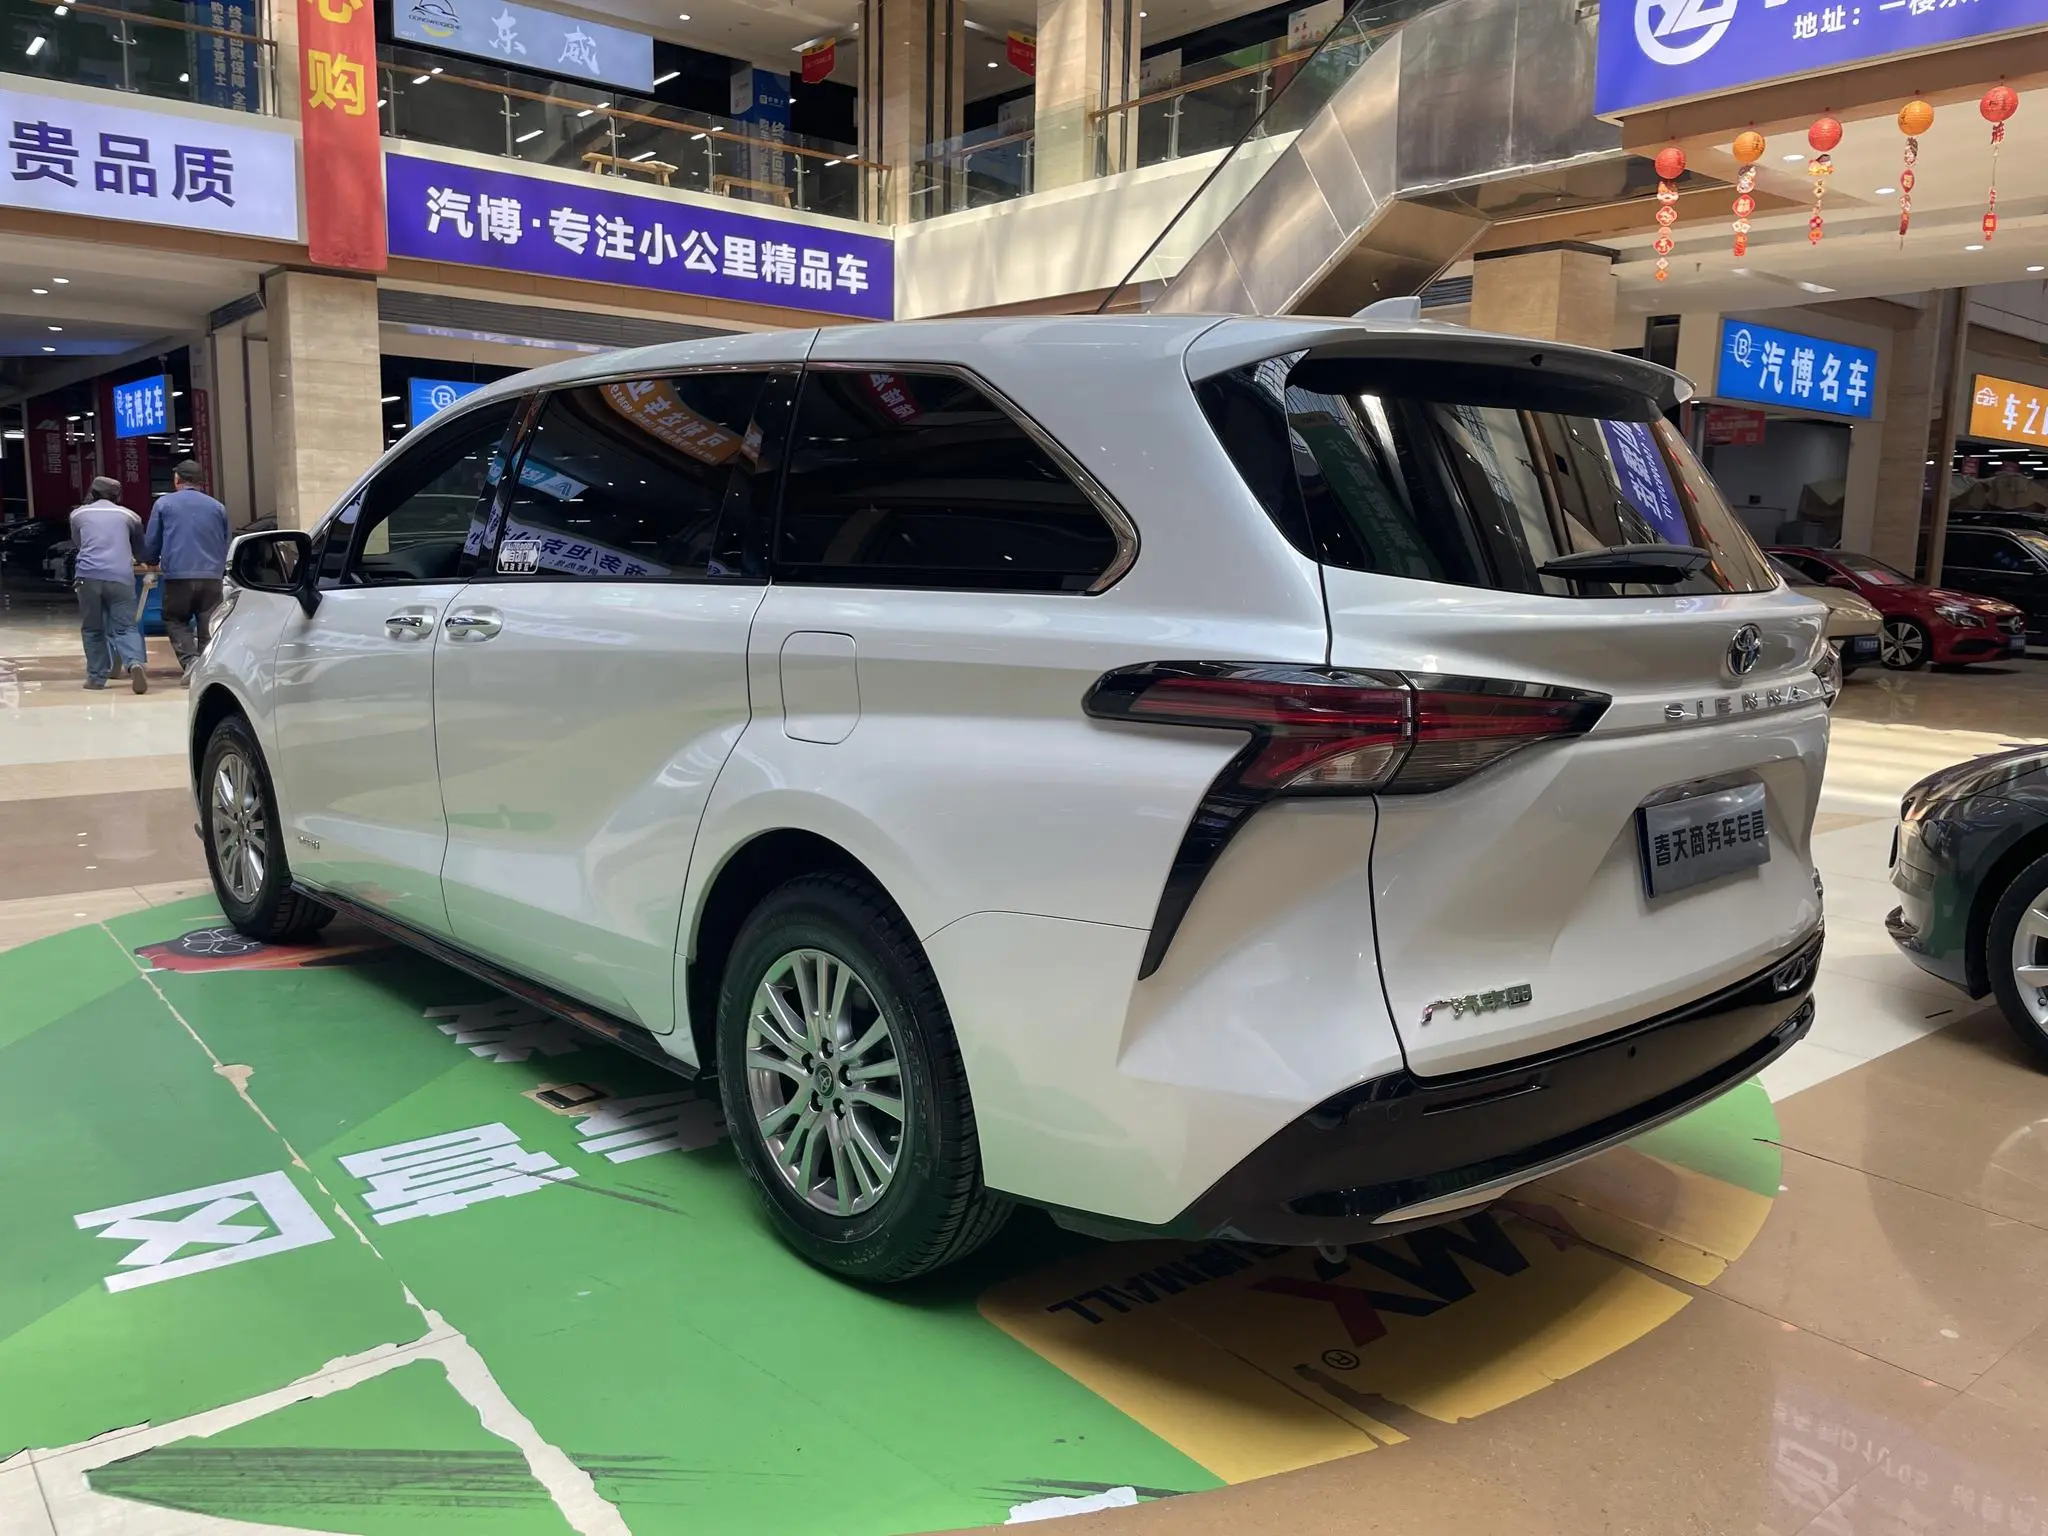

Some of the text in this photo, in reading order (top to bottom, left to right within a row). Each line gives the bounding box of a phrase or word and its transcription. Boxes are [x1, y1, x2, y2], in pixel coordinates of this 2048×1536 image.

[8, 120, 236, 208] 贵品质
[425, 185, 869, 295] 汽博·专注小公里精品车
[1758, 340, 1869, 407] 汽博名车
[124, 384, 165, 429] 汽博名车
[2002, 393, 2048, 436] 车之
[1664, 685, 1813, 721] SIENNA
